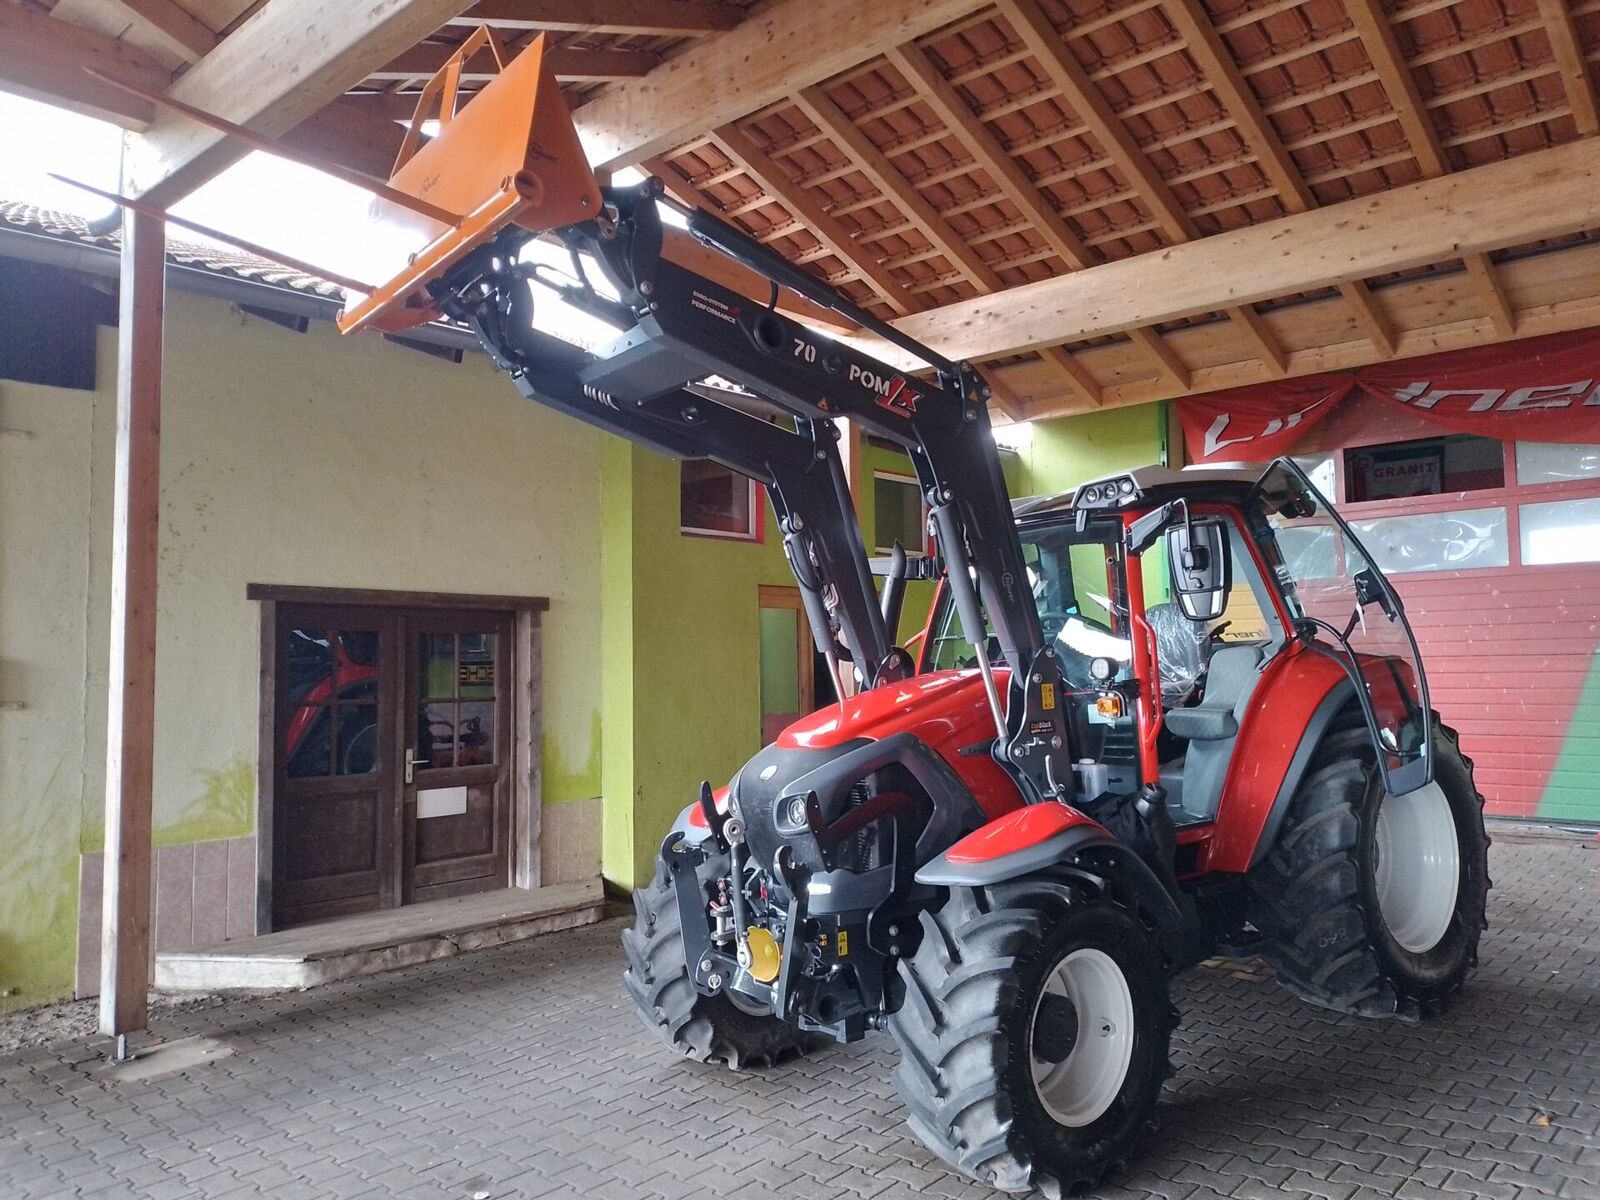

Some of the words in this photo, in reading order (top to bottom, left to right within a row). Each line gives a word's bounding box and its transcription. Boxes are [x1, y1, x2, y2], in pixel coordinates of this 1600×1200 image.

[691, 299, 736, 324] PERFORMANCE
[794, 338, 817, 363] 70
[1374, 462, 1435, 478] GRANIT
